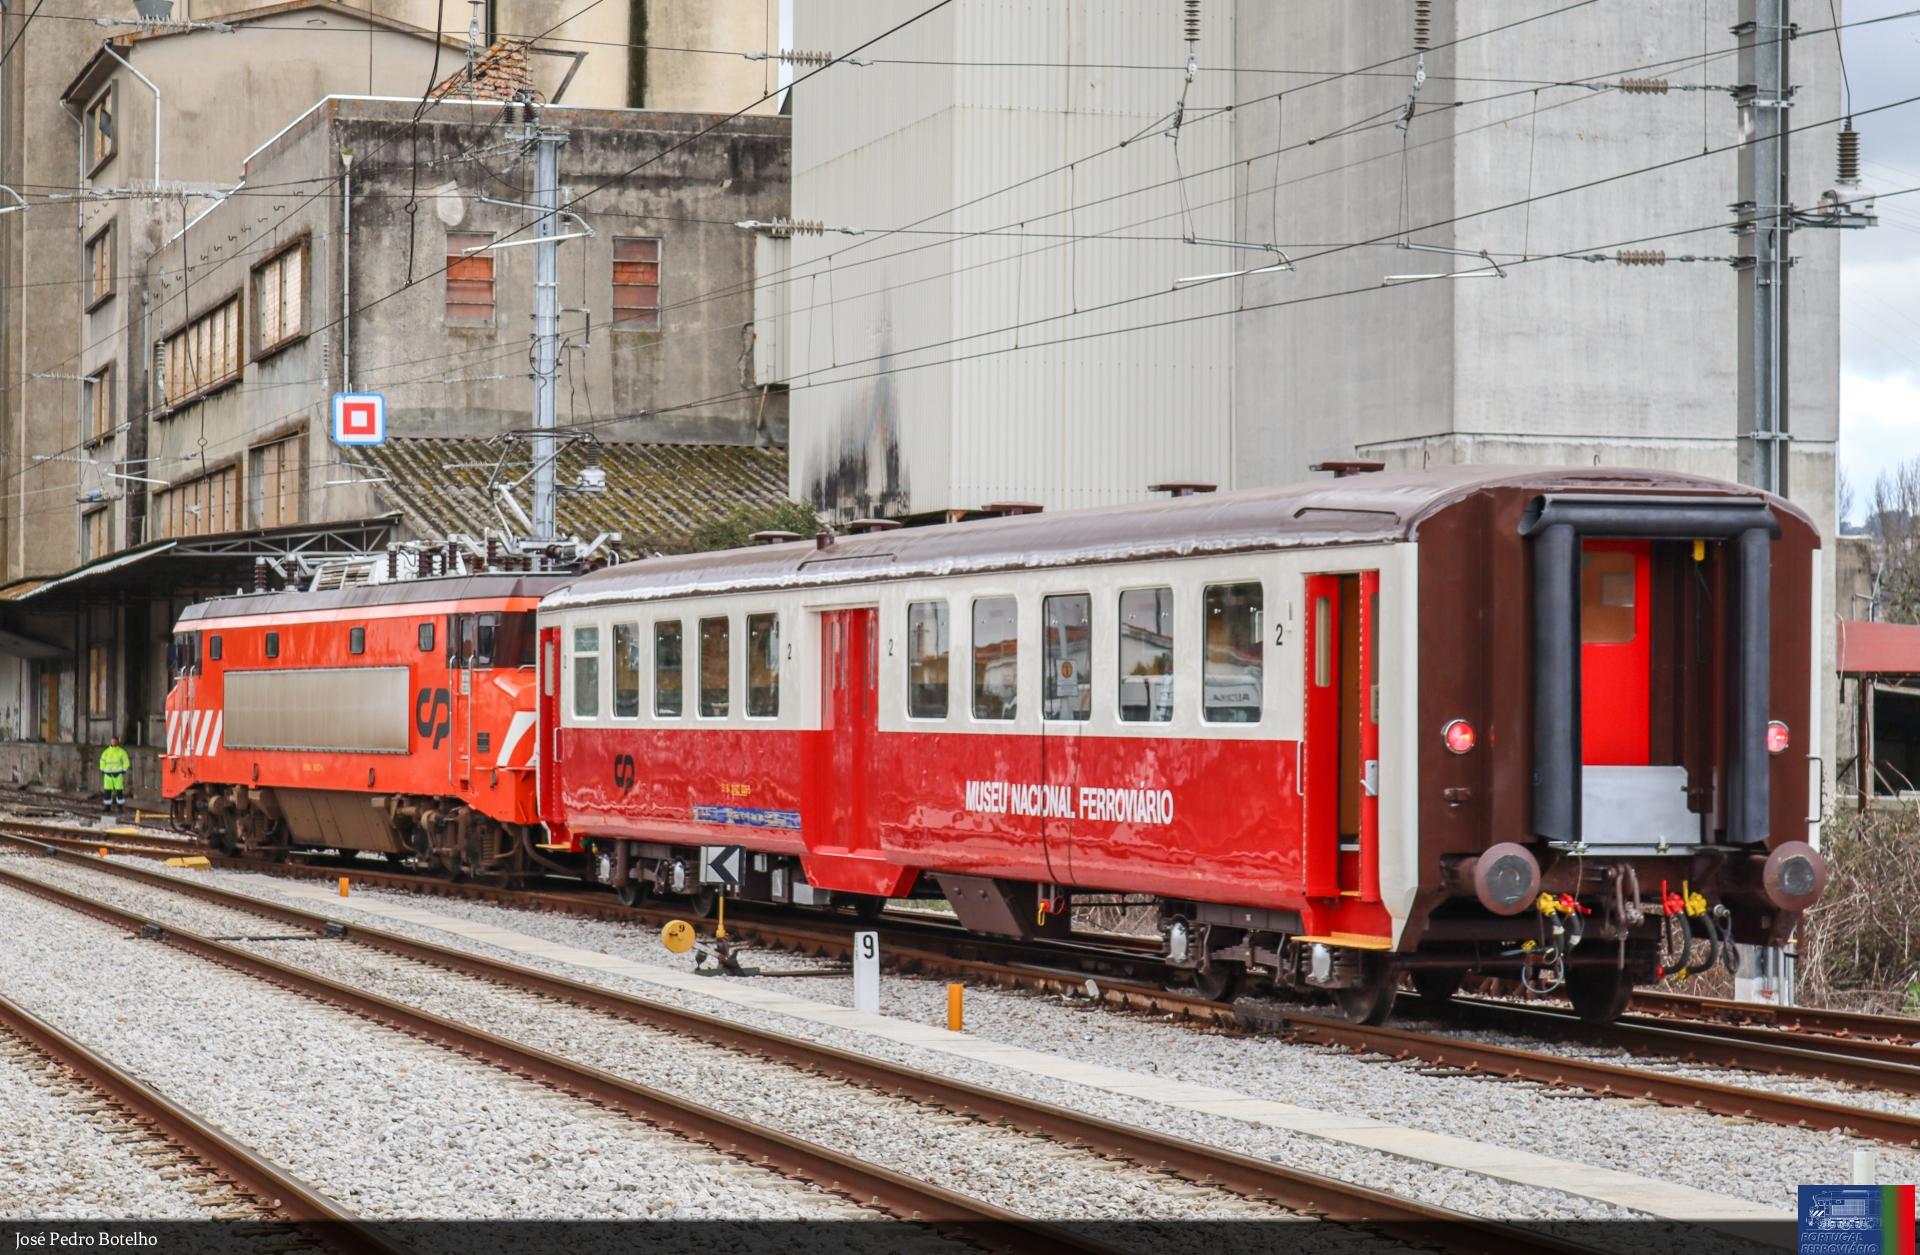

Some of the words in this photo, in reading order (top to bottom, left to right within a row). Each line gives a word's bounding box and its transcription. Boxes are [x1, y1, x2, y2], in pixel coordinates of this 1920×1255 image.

[1275, 623, 1284, 646] 2
[787, 642, 792, 660] 2
[888, 638, 894, 657] 2
[965, 780, 1008, 814] MUSEU
[1011, 783, 1076, 819] NACIONAL
[1079, 782, 1174, 825] FERROVIÁRIO
[679, 924, 685, 933] 9
[863, 934, 875, 960] 9
